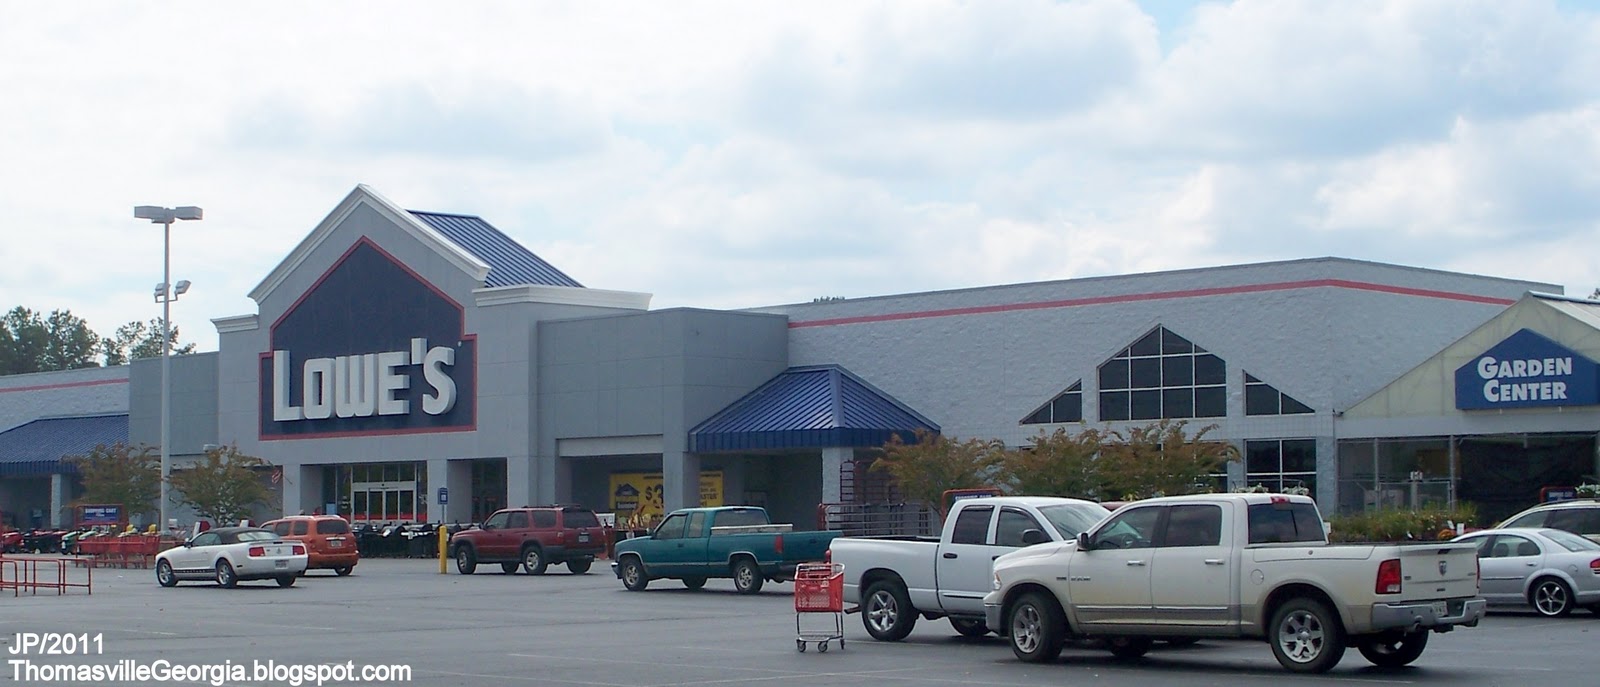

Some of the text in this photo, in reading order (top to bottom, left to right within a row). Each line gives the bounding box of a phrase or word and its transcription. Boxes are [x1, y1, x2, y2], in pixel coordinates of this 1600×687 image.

[273, 338, 457, 422] LOWE'S
[1477, 356, 1573, 380] GARDEN
[1483, 379, 1568, 403] CENTER
